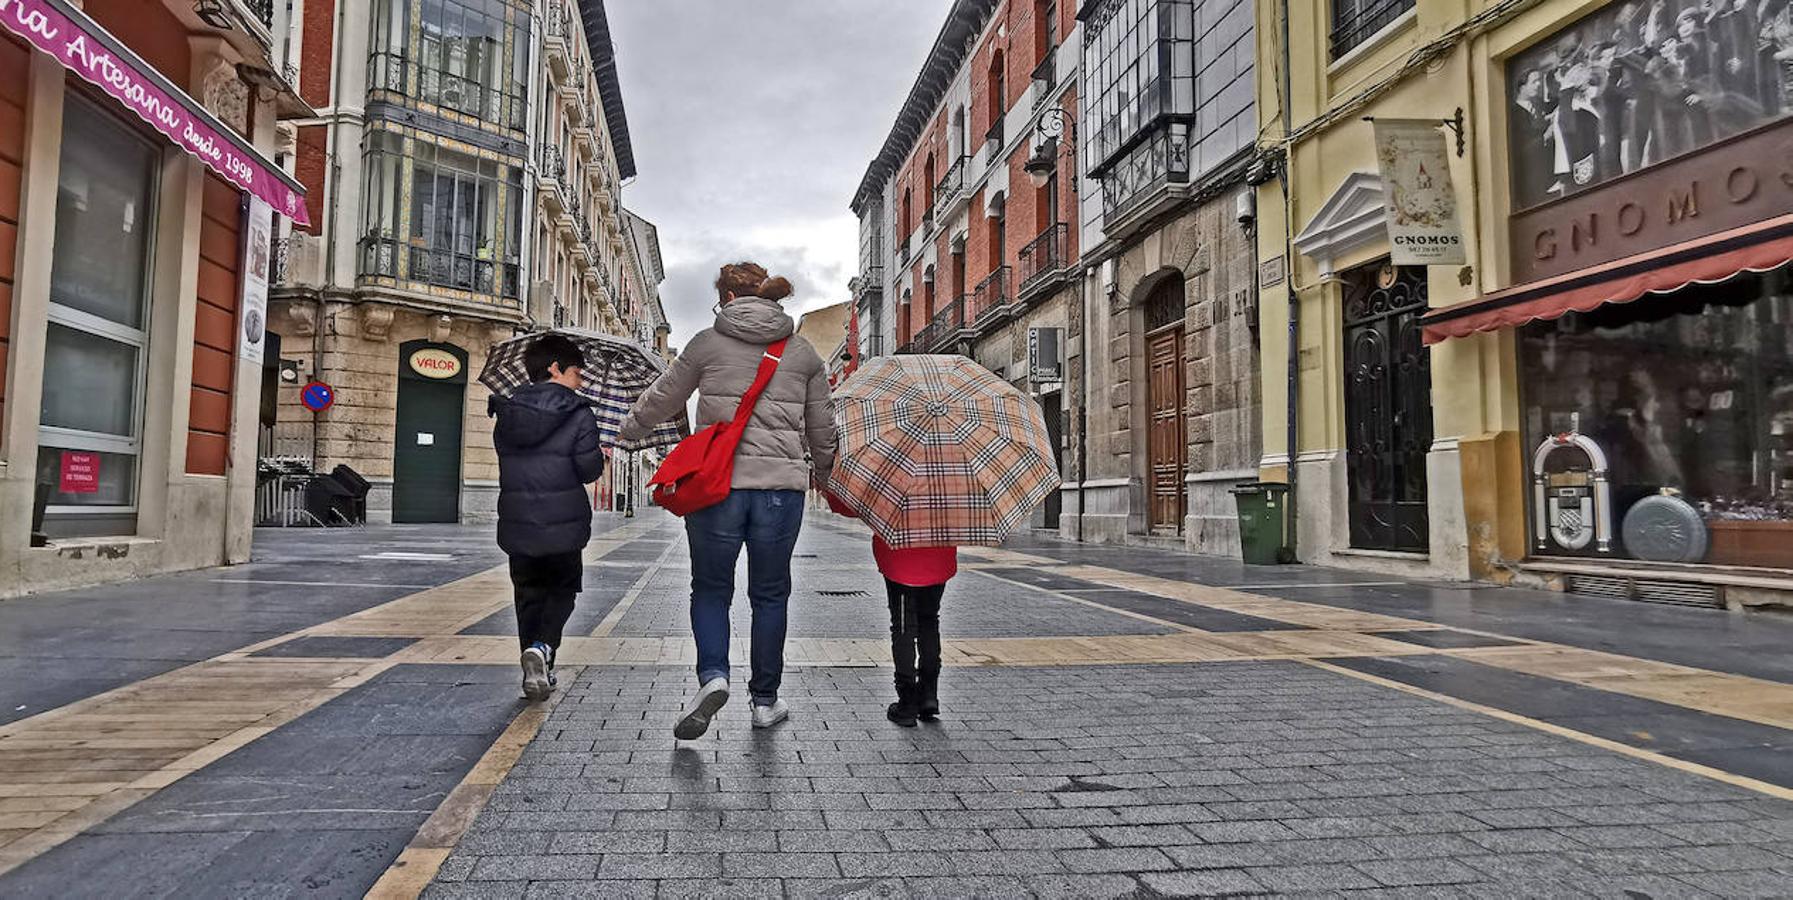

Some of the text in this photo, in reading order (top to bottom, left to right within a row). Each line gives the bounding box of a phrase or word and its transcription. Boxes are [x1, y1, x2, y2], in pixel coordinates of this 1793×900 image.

[66, 35, 181, 129] Artesana
[183, 120, 223, 161] desde
[225, 152, 254, 184] 1998
[1394, 235, 1459, 245] GNOMOS
[415, 356, 456, 372] VALOR
[1029, 329, 1038, 381] OPTICA
